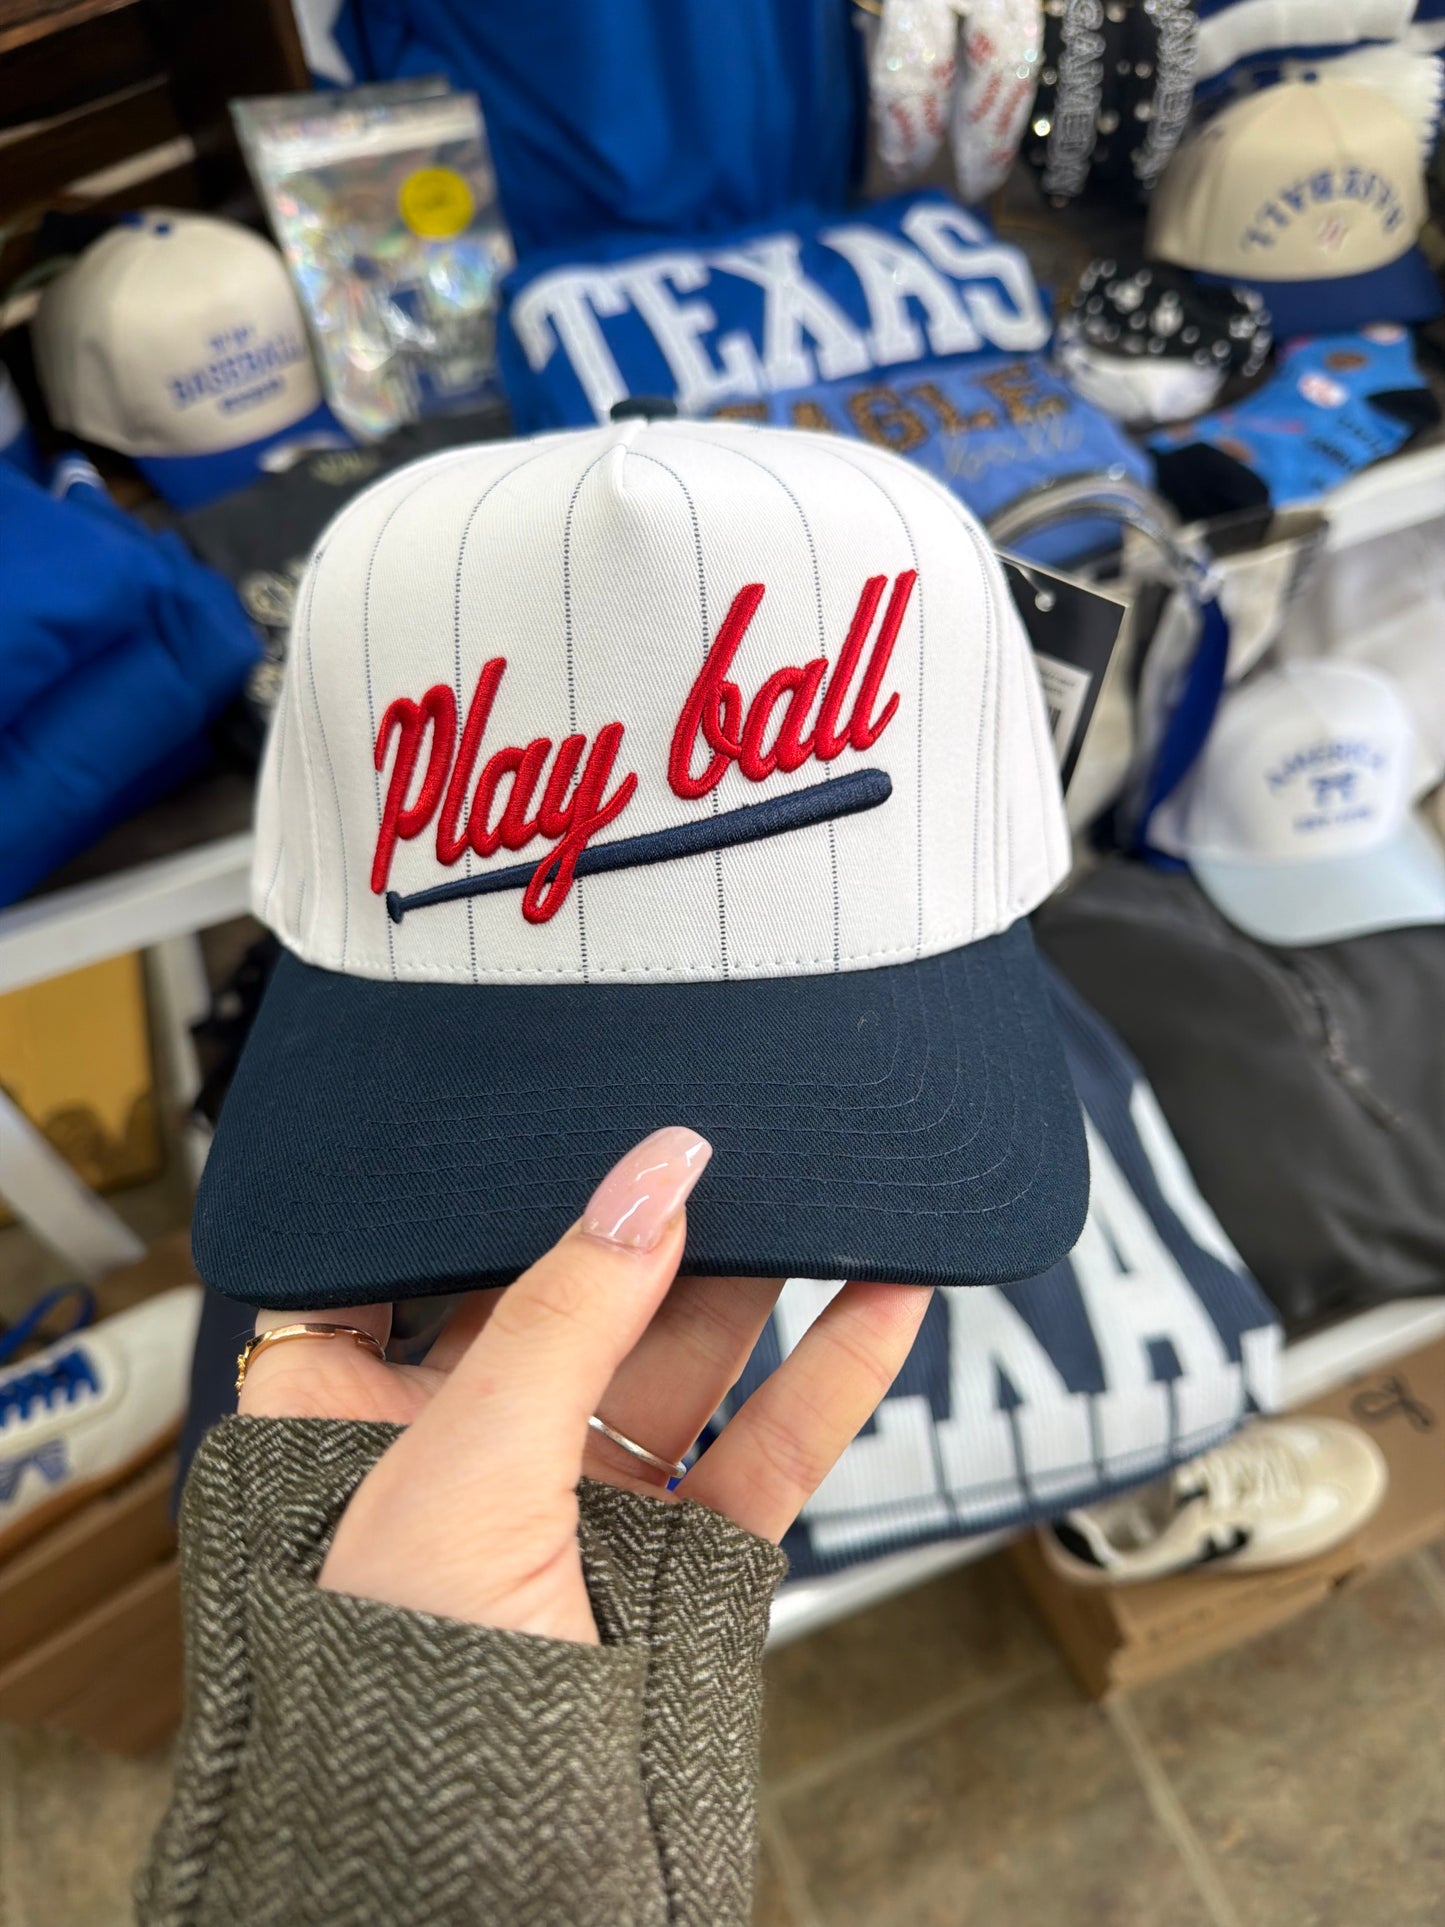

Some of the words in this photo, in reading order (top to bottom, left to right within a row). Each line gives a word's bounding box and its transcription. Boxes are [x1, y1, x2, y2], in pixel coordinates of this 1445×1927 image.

[510, 203, 1052, 424] TEXAS
[712, 362, 1067, 452] GLE
[370, 657, 638, 924] Play
[667, 569, 918, 799] ball
